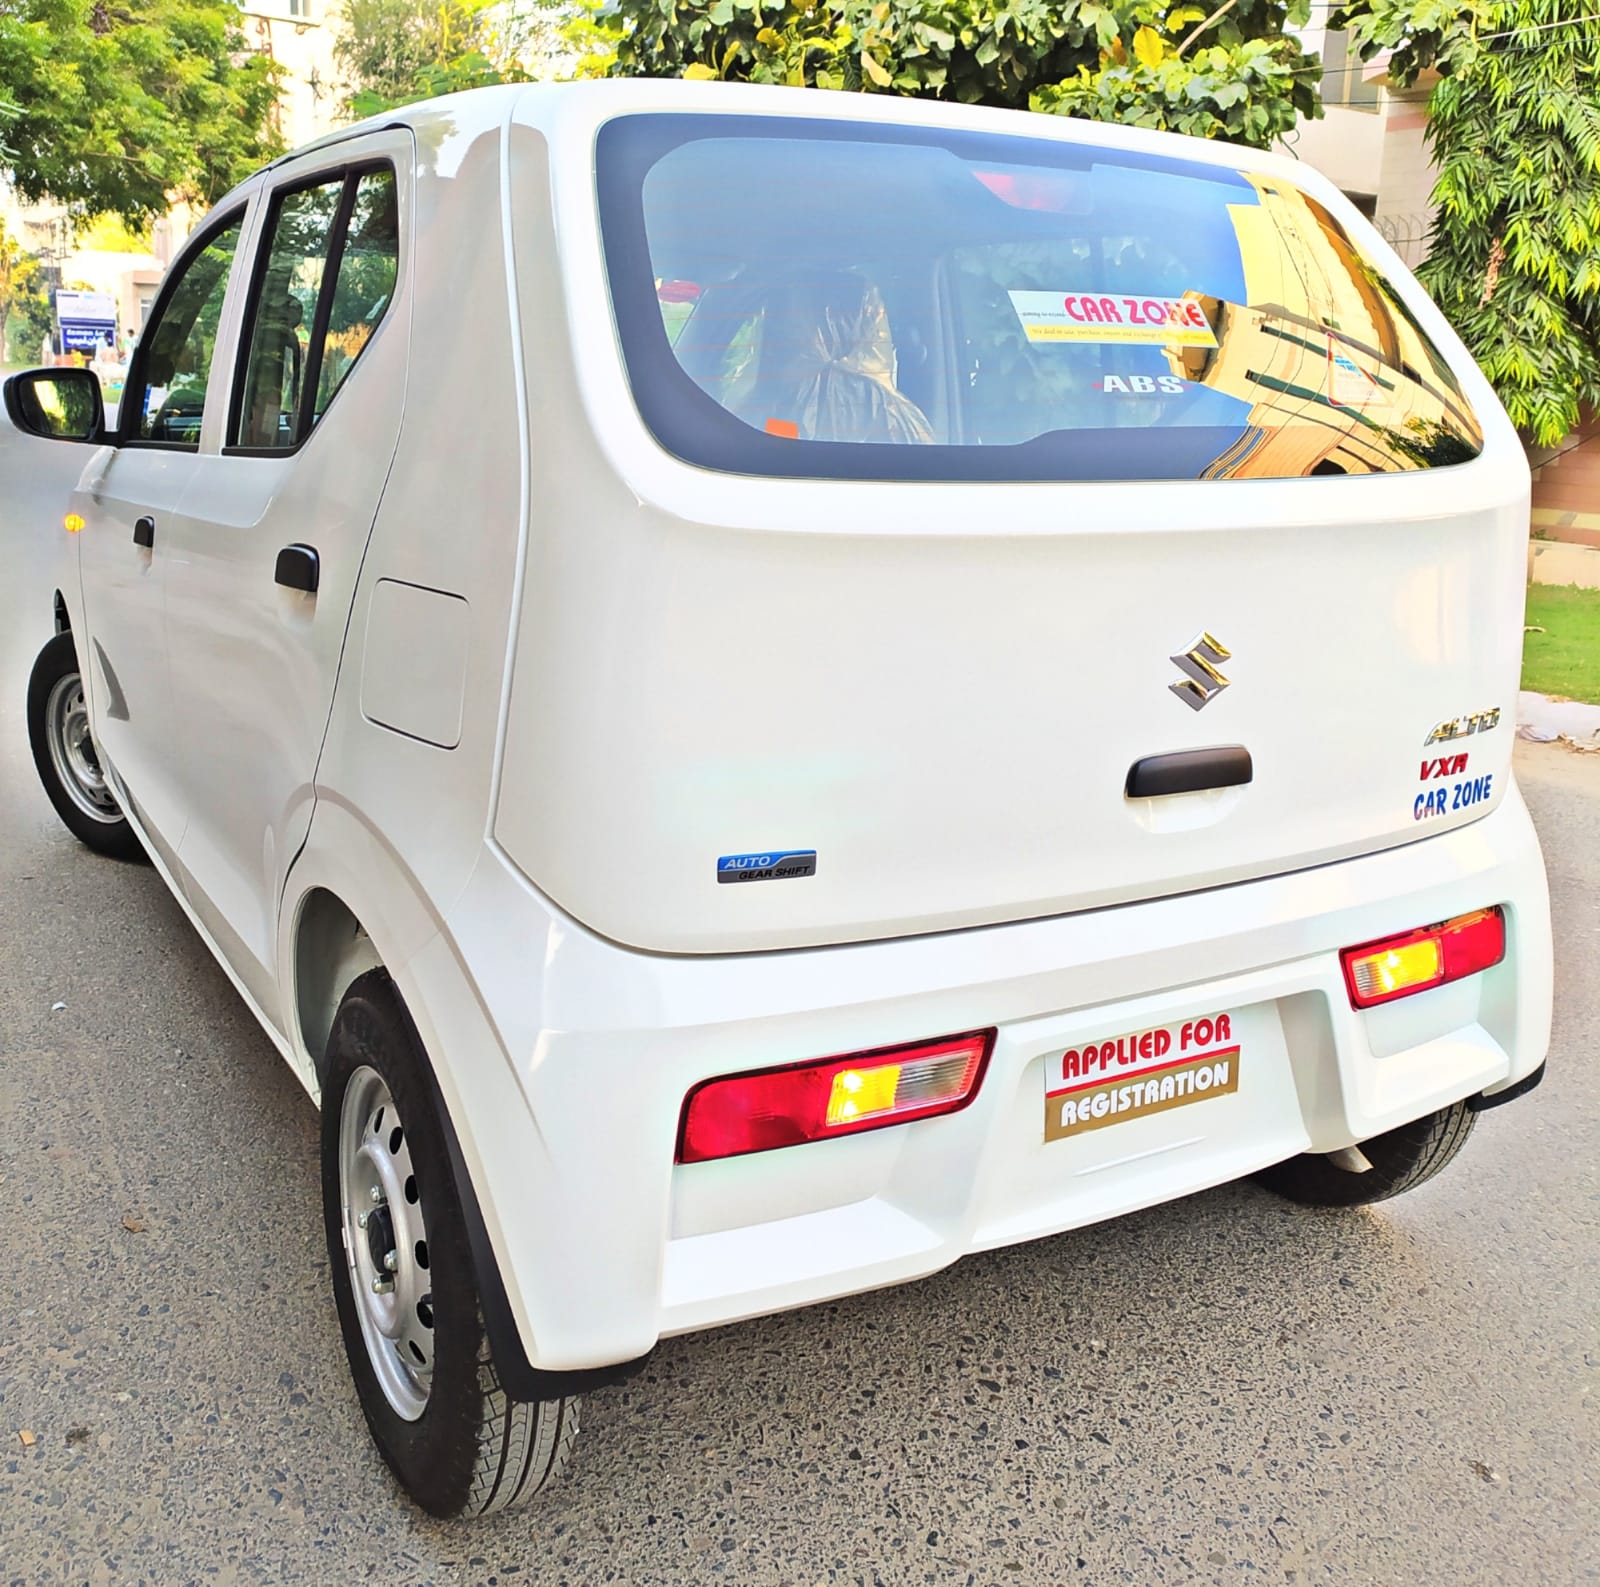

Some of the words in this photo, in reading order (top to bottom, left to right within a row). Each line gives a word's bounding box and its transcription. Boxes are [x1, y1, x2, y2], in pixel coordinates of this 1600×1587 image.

[1064, 296, 1123, 323] CAR
[1123, 299, 1205, 327] ZONE
[1103, 375, 1184, 393] ABS
[1424, 706, 1500, 747] ALTO
[1420, 752, 1469, 781] VXR
[1413, 788, 1447, 821] CAR
[1452, 774, 1493, 810] ZONE
[724, 855, 771, 869] AUTO
[738, 868, 773, 880] GEAR
[775, 866, 811, 877] SHIFT
[1062, 1028, 1172, 1080] APPLIED
[1180, 1013, 1231, 1051] FOR
[1060, 1060, 1230, 1128] REGISTRATION
